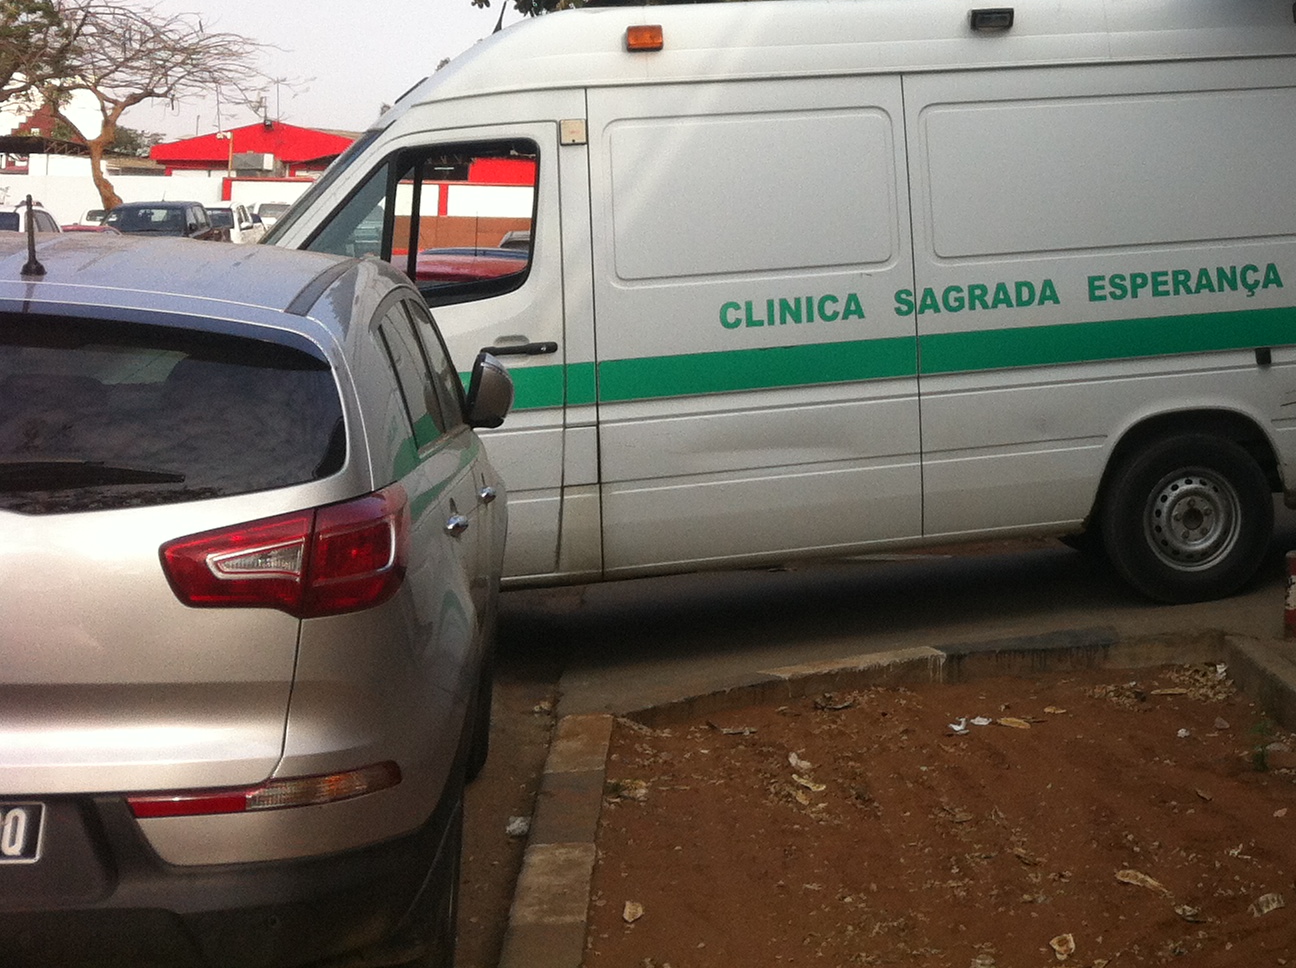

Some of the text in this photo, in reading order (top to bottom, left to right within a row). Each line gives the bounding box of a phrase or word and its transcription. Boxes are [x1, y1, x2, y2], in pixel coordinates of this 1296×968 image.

[719, 262, 1284, 330] CLINICA SAGRADA ESPERANÇA
